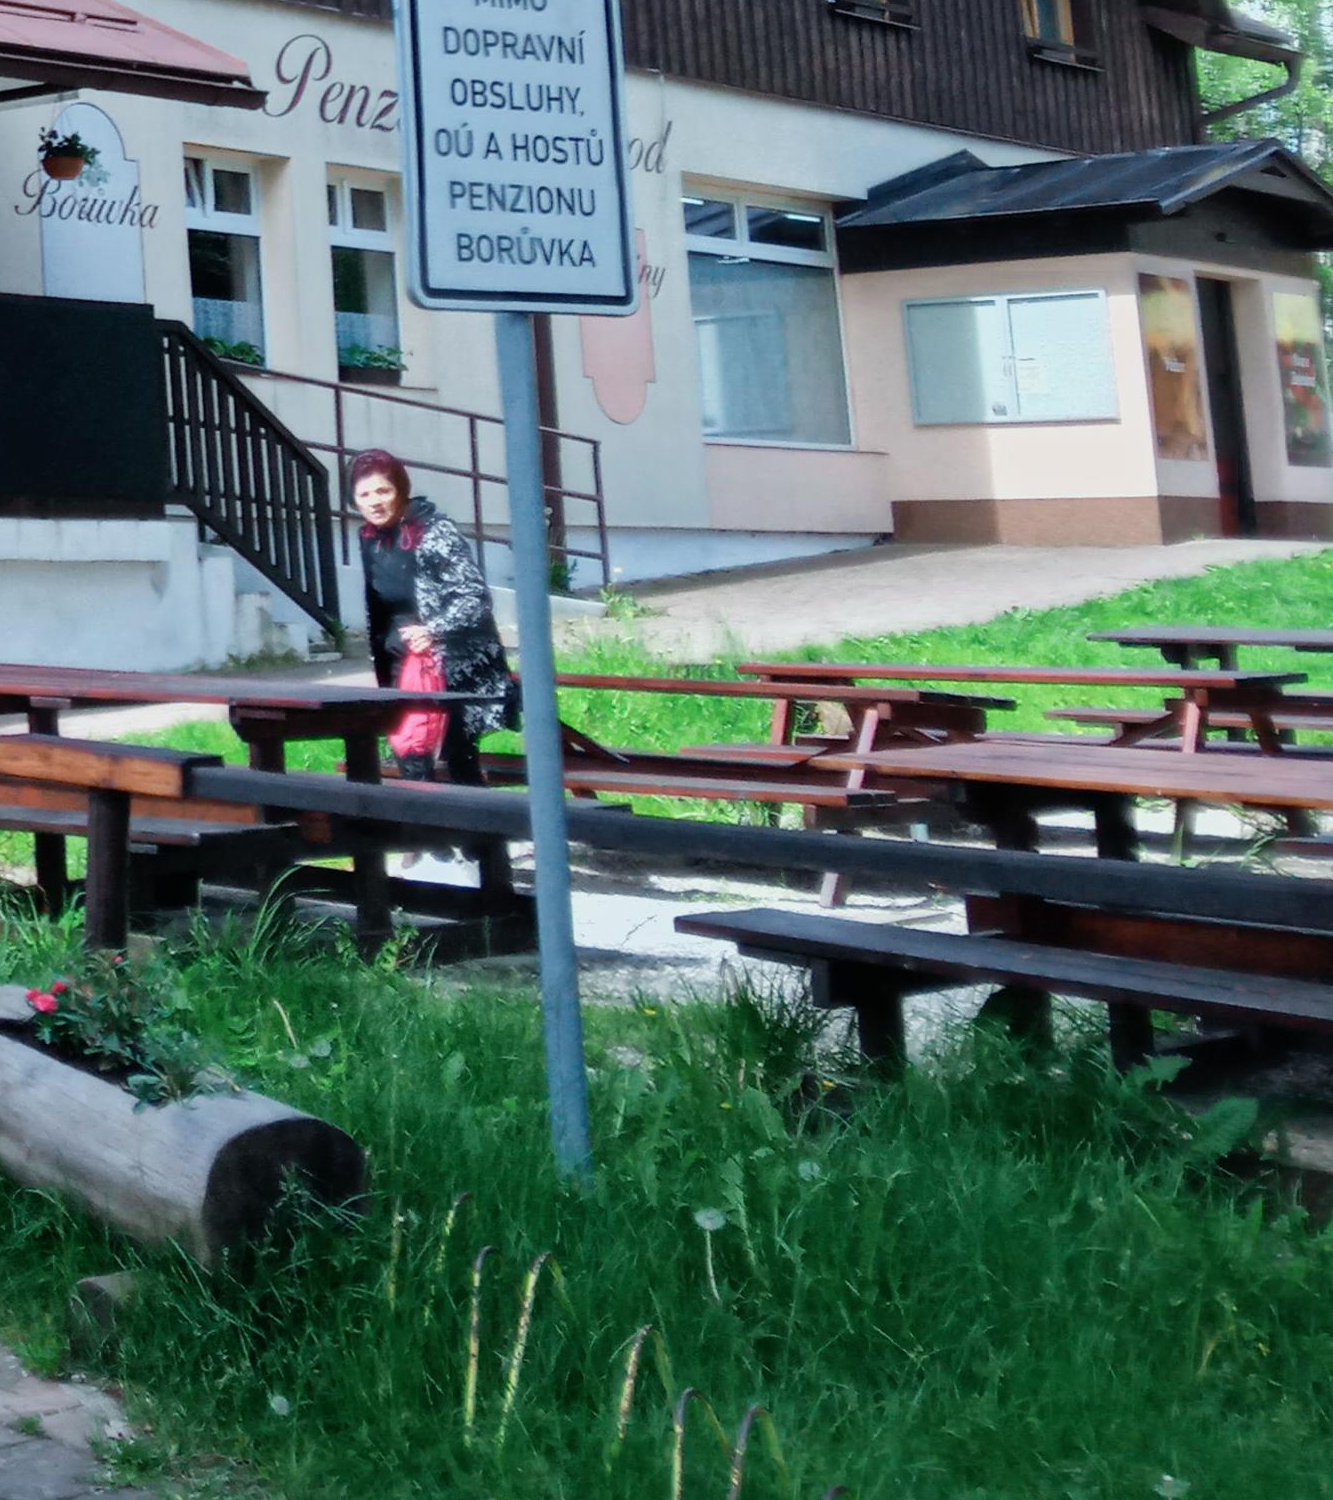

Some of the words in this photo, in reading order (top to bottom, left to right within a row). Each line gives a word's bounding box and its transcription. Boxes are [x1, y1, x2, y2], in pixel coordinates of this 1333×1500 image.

[443, 26, 586, 65] DOPRAVNÍ
[262, 34, 401, 133] Penz
[451, 78, 585, 117] OBSLUHY,
[434, 122, 474, 158] OÚ
[484, 132, 503, 162] A
[511, 129, 604, 167] HOSTŮ
[449, 180, 596, 217] PENZIONU
[456, 227, 596, 268] BORŮVKA
